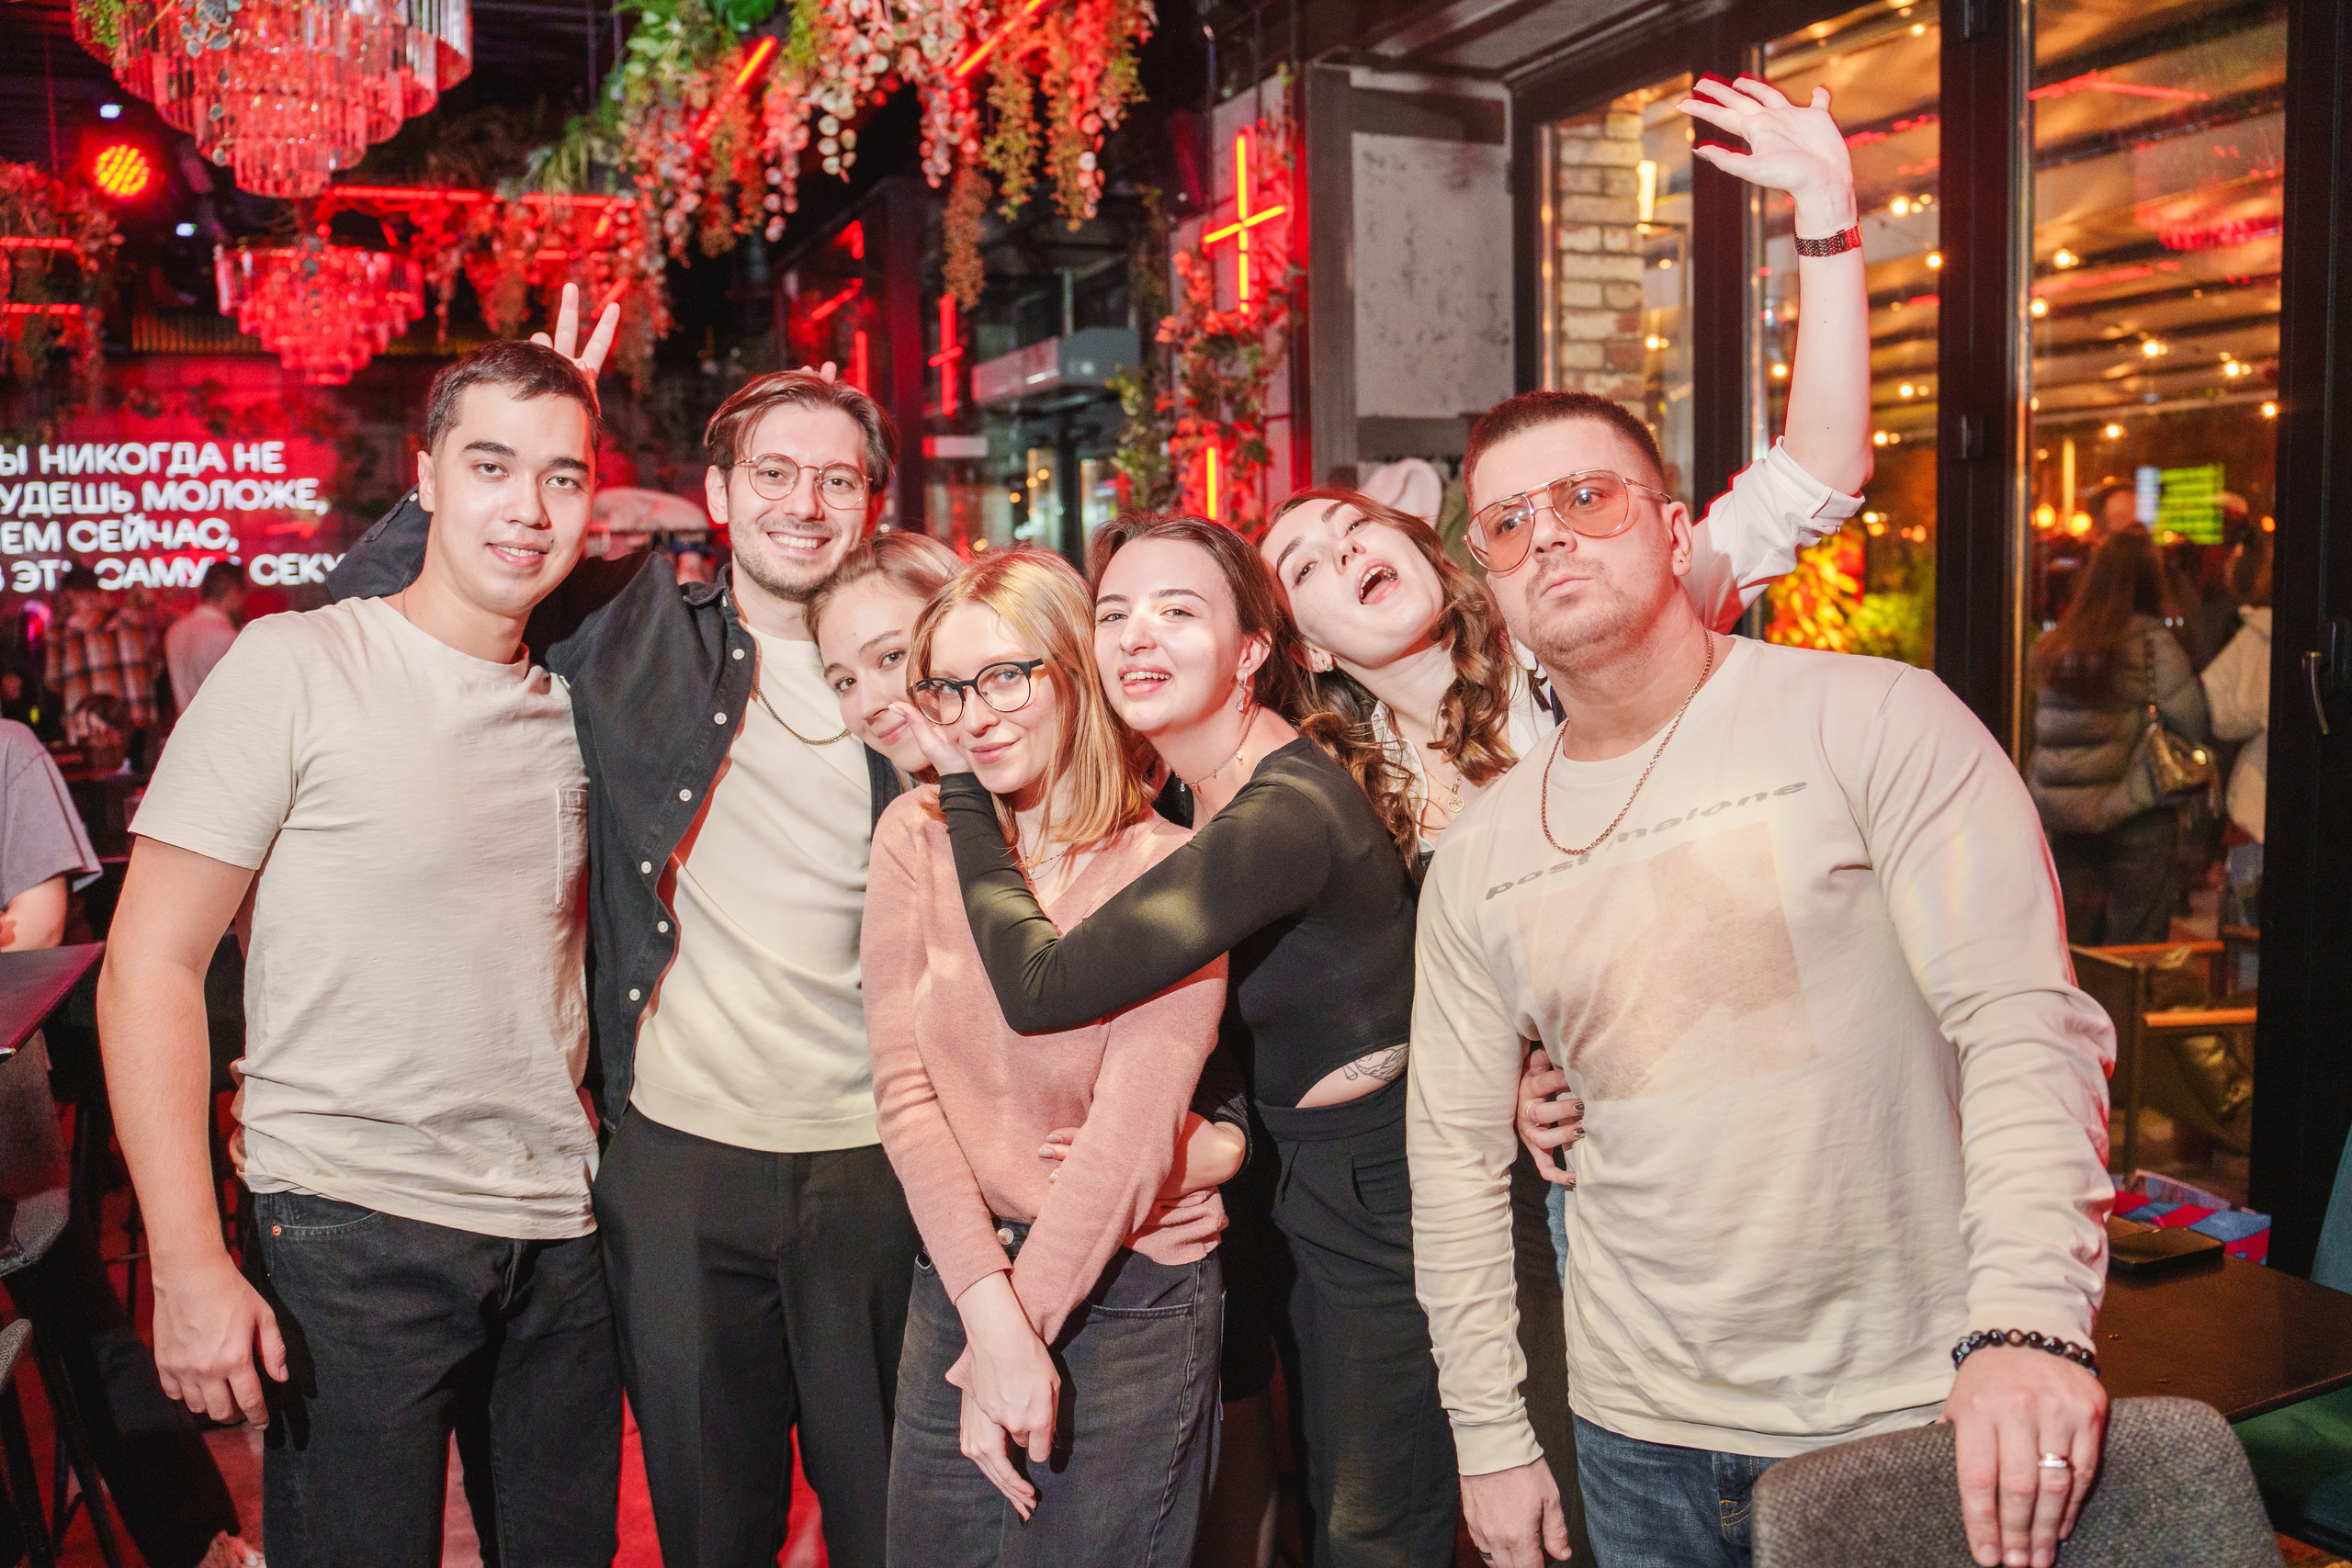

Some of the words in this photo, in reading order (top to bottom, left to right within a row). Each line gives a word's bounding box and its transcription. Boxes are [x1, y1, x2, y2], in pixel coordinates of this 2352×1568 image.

[39, 442, 228, 479] НИКОГДА
[233, 441, 287, 474] НЕ
[141, 478, 330, 516] МОЛОЖЕ,
[1, 521, 62, 555] ЕМ
[67, 513, 240, 553] СЕЙЧАС,
[10, 558, 73, 593] ЭТ
[94, 556, 243, 590] САМУ
[1485, 852, 1592, 901] post
